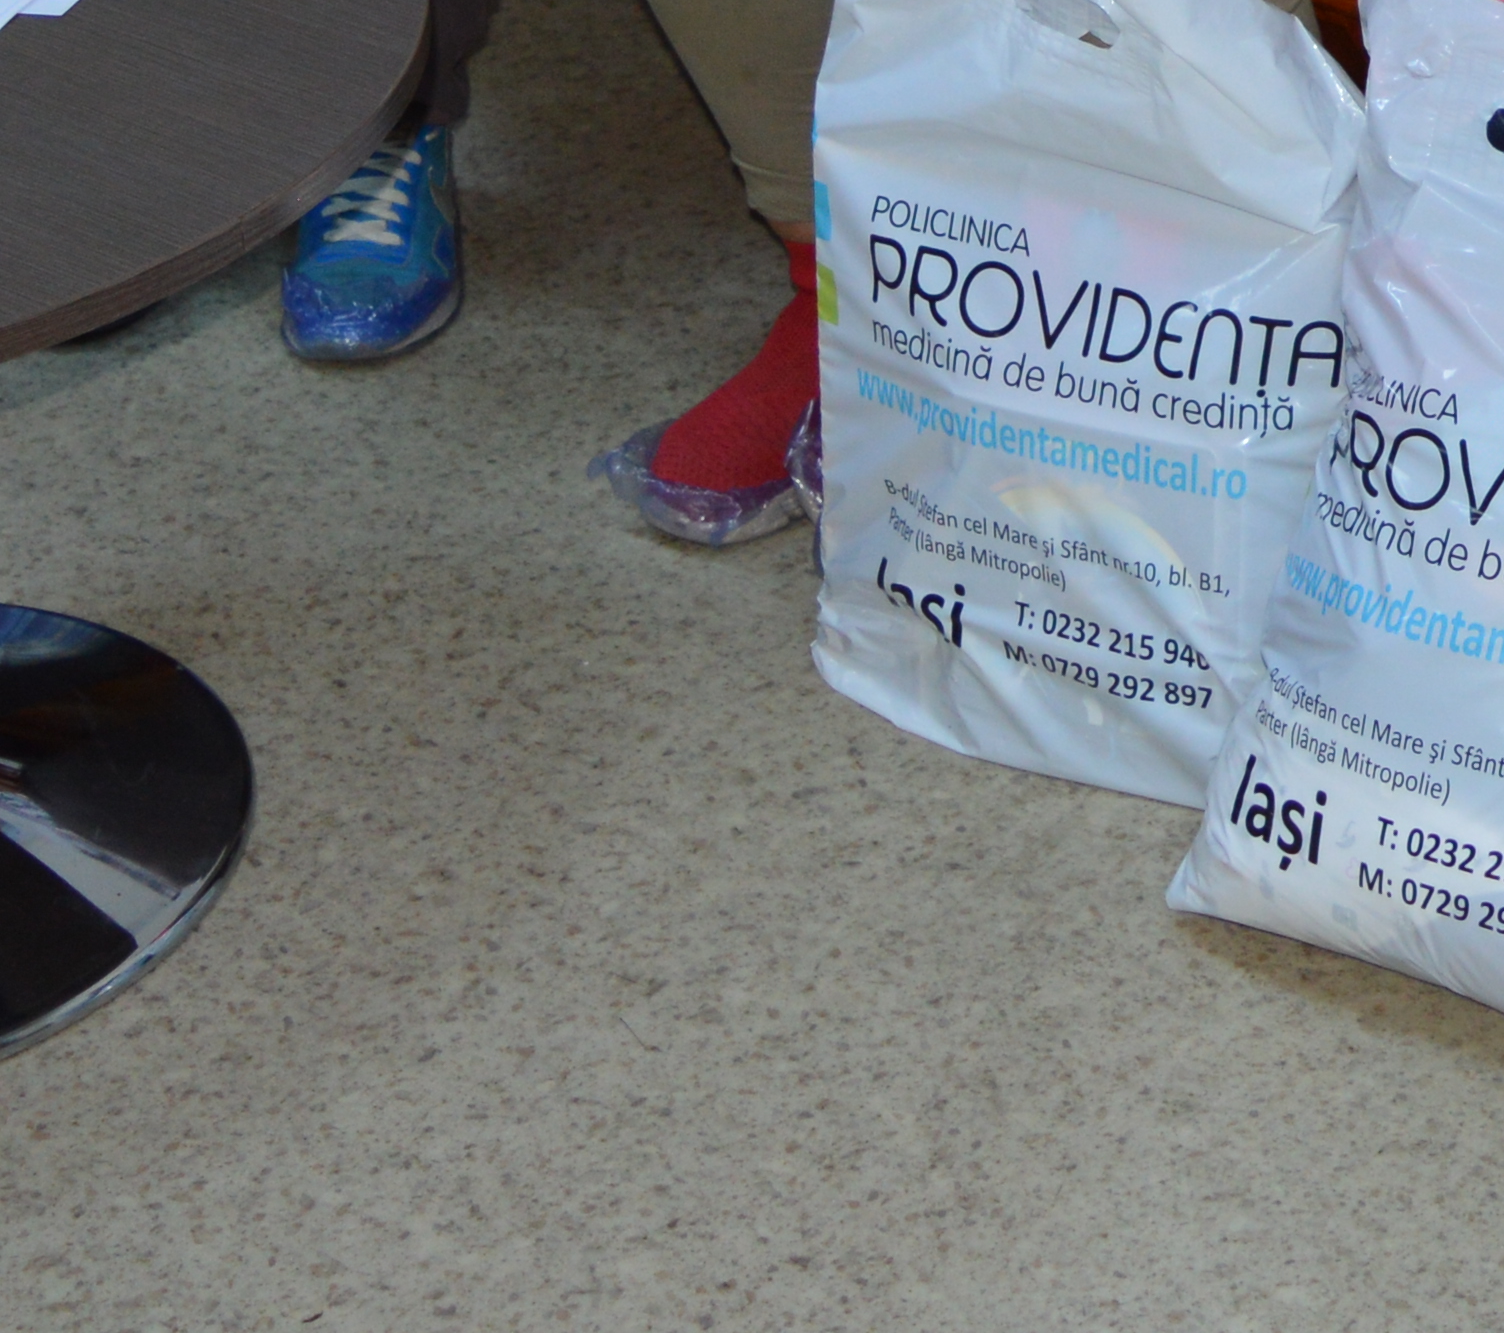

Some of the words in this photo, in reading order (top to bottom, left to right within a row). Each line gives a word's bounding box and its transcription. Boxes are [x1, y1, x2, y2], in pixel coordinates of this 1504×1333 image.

[870, 194, 1031, 258] POLICLINICA
[871, 318, 993, 382] medicină
[1003, 352, 1045, 392] de
[1054, 360, 1141, 415] bună
[1152, 391, 1295, 439] credință
[856, 366, 1248, 501] www.providentamedical.ro
[915, 528, 966, 562] (lângă
[970, 544, 1068, 593] Mitropolie)
[962, 515, 988, 537] cel
[992, 520, 1038, 550] Mare
[1060, 539, 1109, 568] Sfânt
[1167, 564, 1193, 589] bl.
[1198, 571, 1231, 599] B1,
[1423, 527, 1469, 573] de
[1014, 600, 1036, 631] T:
[1041, 608, 1102, 649] 0232
[1108, 627, 1156, 662] 215
[1002, 639, 1038, 668] M:
[1041, 652, 1101, 689] 0729
[1107, 671, 1156, 703] 292
[1163, 681, 1214, 710] 897
[1254, 698, 1289, 739] Parter
[1289, 721, 1337, 764] (lângă
[1340, 746, 1451, 808] Mitropolie)
[1340, 713, 1368, 737] cel
[1370, 718, 1425, 756] Mare
[1230, 753, 1328, 872] Iași
[1377, 815, 1399, 851] T:
[1406, 827, 1477, 875] 0232
[1358, 861, 1394, 897] M:
[1401, 877, 1471, 922] 0729
